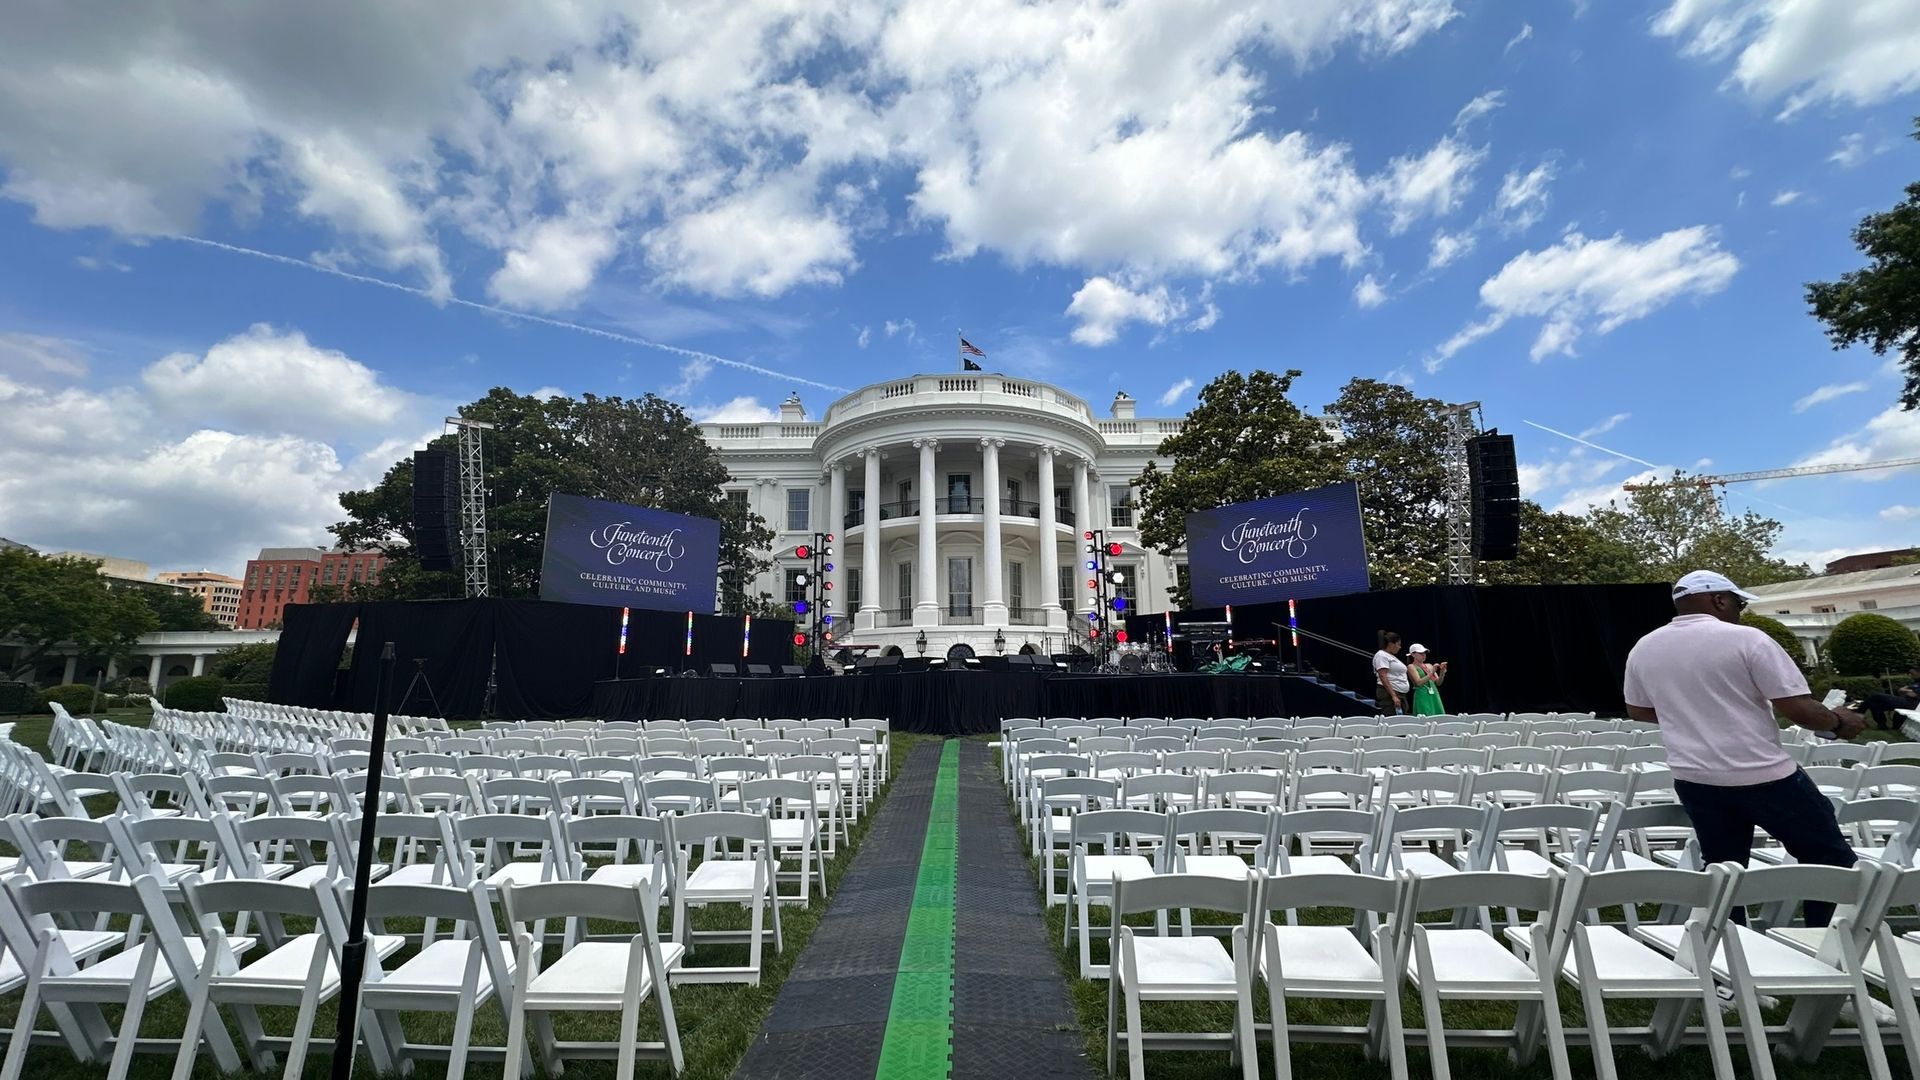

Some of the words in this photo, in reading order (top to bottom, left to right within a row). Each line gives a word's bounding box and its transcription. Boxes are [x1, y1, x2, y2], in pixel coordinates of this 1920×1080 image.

[590, 521, 685, 559] Juneteenth
[1221, 507, 1317, 551] Juneteenth
[606, 542, 673, 573] Concert
[1238, 535, 1307, 564] Concert
[580, 572, 637, 585] CELEBRATING
[638, 578, 688, 591] COMMUNITY,
[1219, 571, 1272, 584] CELEBRATING
[1273, 564, 1329, 578] COMMUNITY,
[1231, 579, 1270, 590] CULTURE,
[1271, 576, 1289, 585] AND
[1290, 573, 1317, 583] MUSIC
[592, 581, 633, 592] CULTURE,
[634, 585, 651, 594] AND
[652, 587, 677, 596] MUSIC
